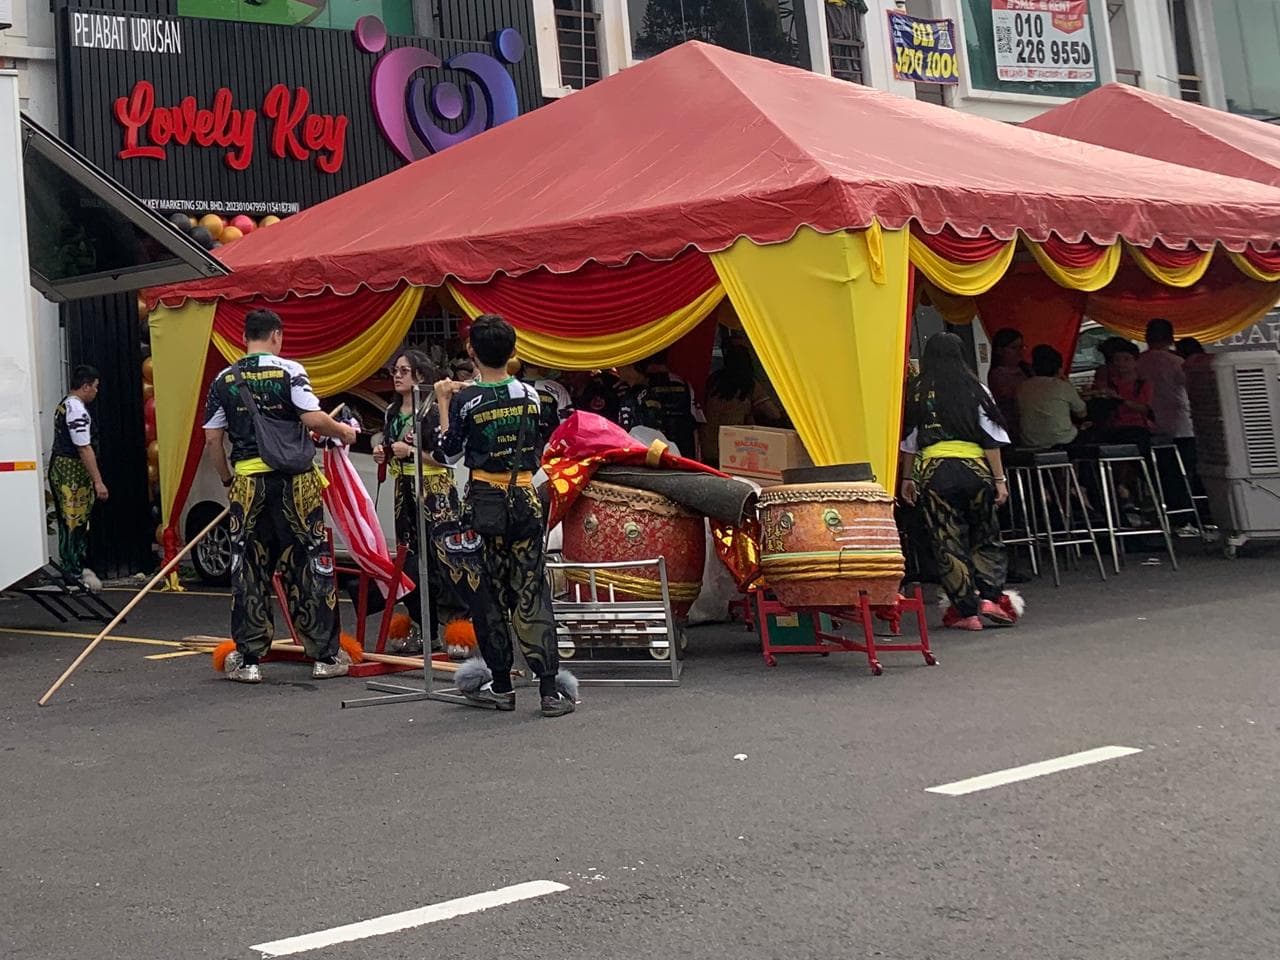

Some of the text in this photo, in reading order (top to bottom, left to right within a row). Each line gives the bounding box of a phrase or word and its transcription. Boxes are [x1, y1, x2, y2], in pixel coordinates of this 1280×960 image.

[74, 13, 181, 54] PEJABAT URUSAN
[1015, 13, 1043, 38] 010
[1016, 39, 1091, 65] 226 9550
[114, 80, 349, 173] Lovely Key
[160, 199, 195, 210] MARKETING
